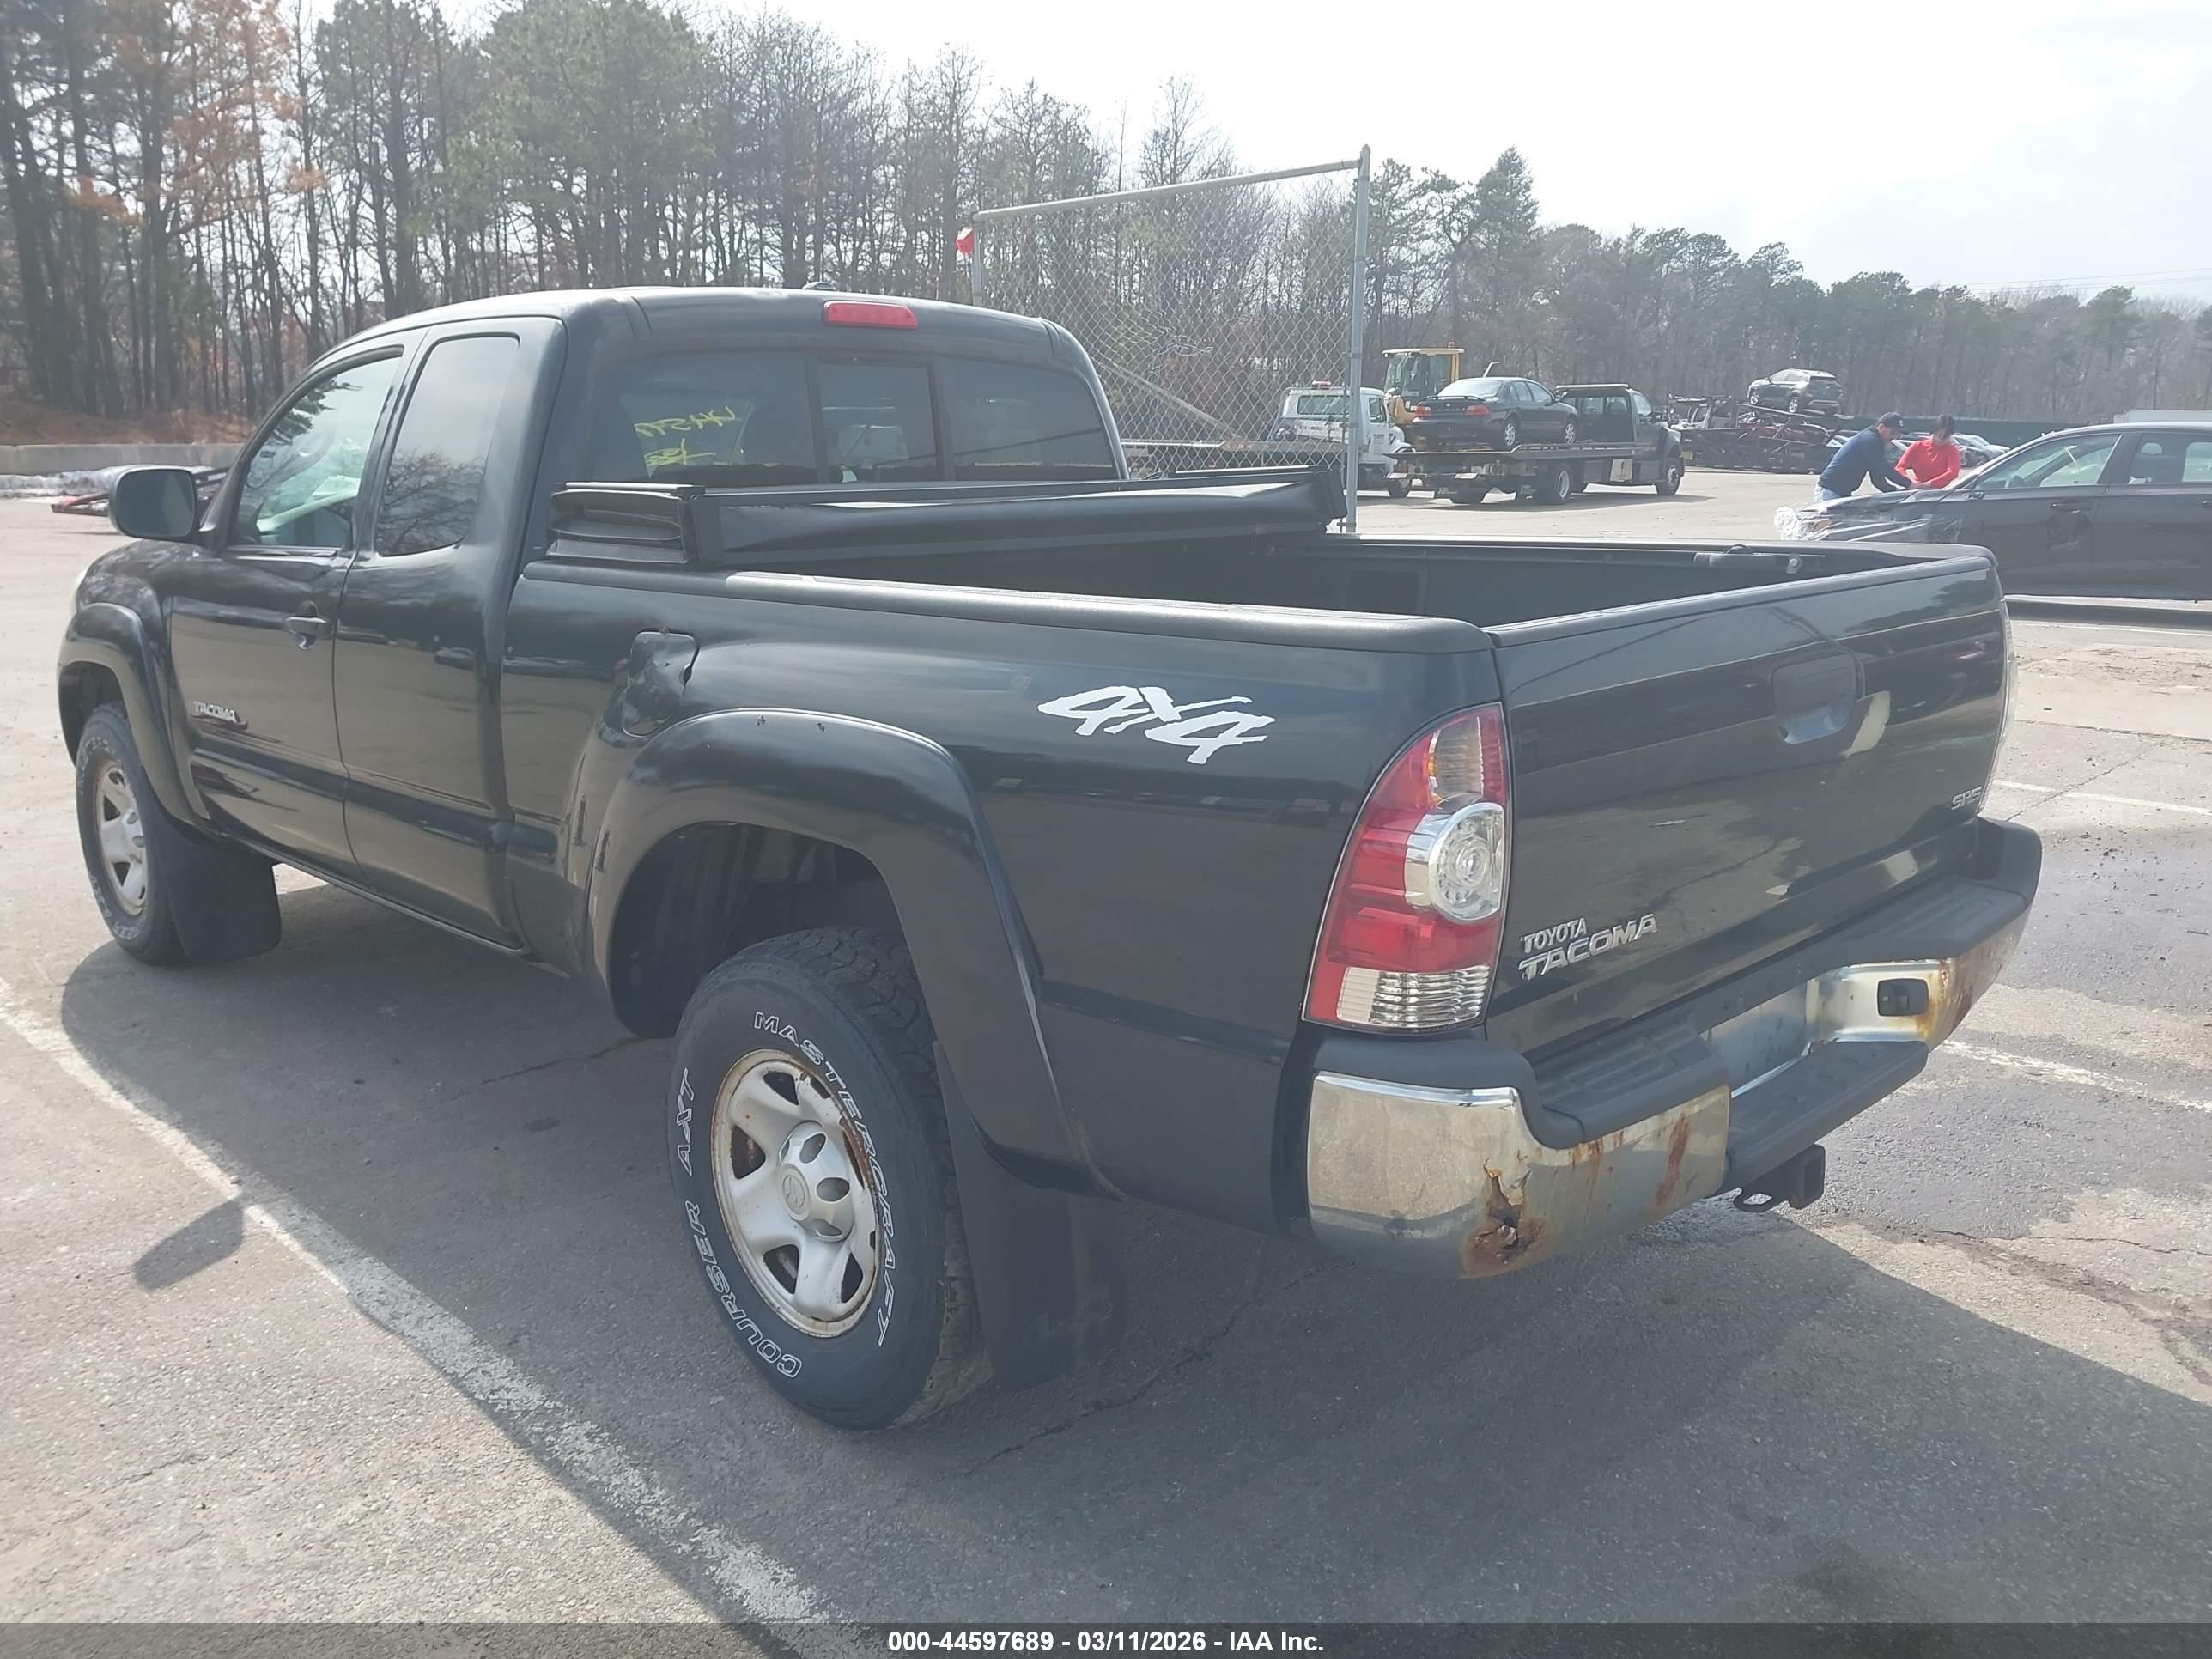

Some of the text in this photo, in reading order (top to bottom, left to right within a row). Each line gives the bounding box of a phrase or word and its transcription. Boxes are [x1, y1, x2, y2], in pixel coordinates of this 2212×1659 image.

[193, 700, 237, 724] TACOMA
[1951, 786, 1982, 811] SR5
[1517, 913, 1658, 981] TACOMA
[1520, 917, 1588, 954] TOYOTA
[753, 1011, 896, 1346] MASTERCRAFT
[685, 1200, 803, 1378] COURSER
